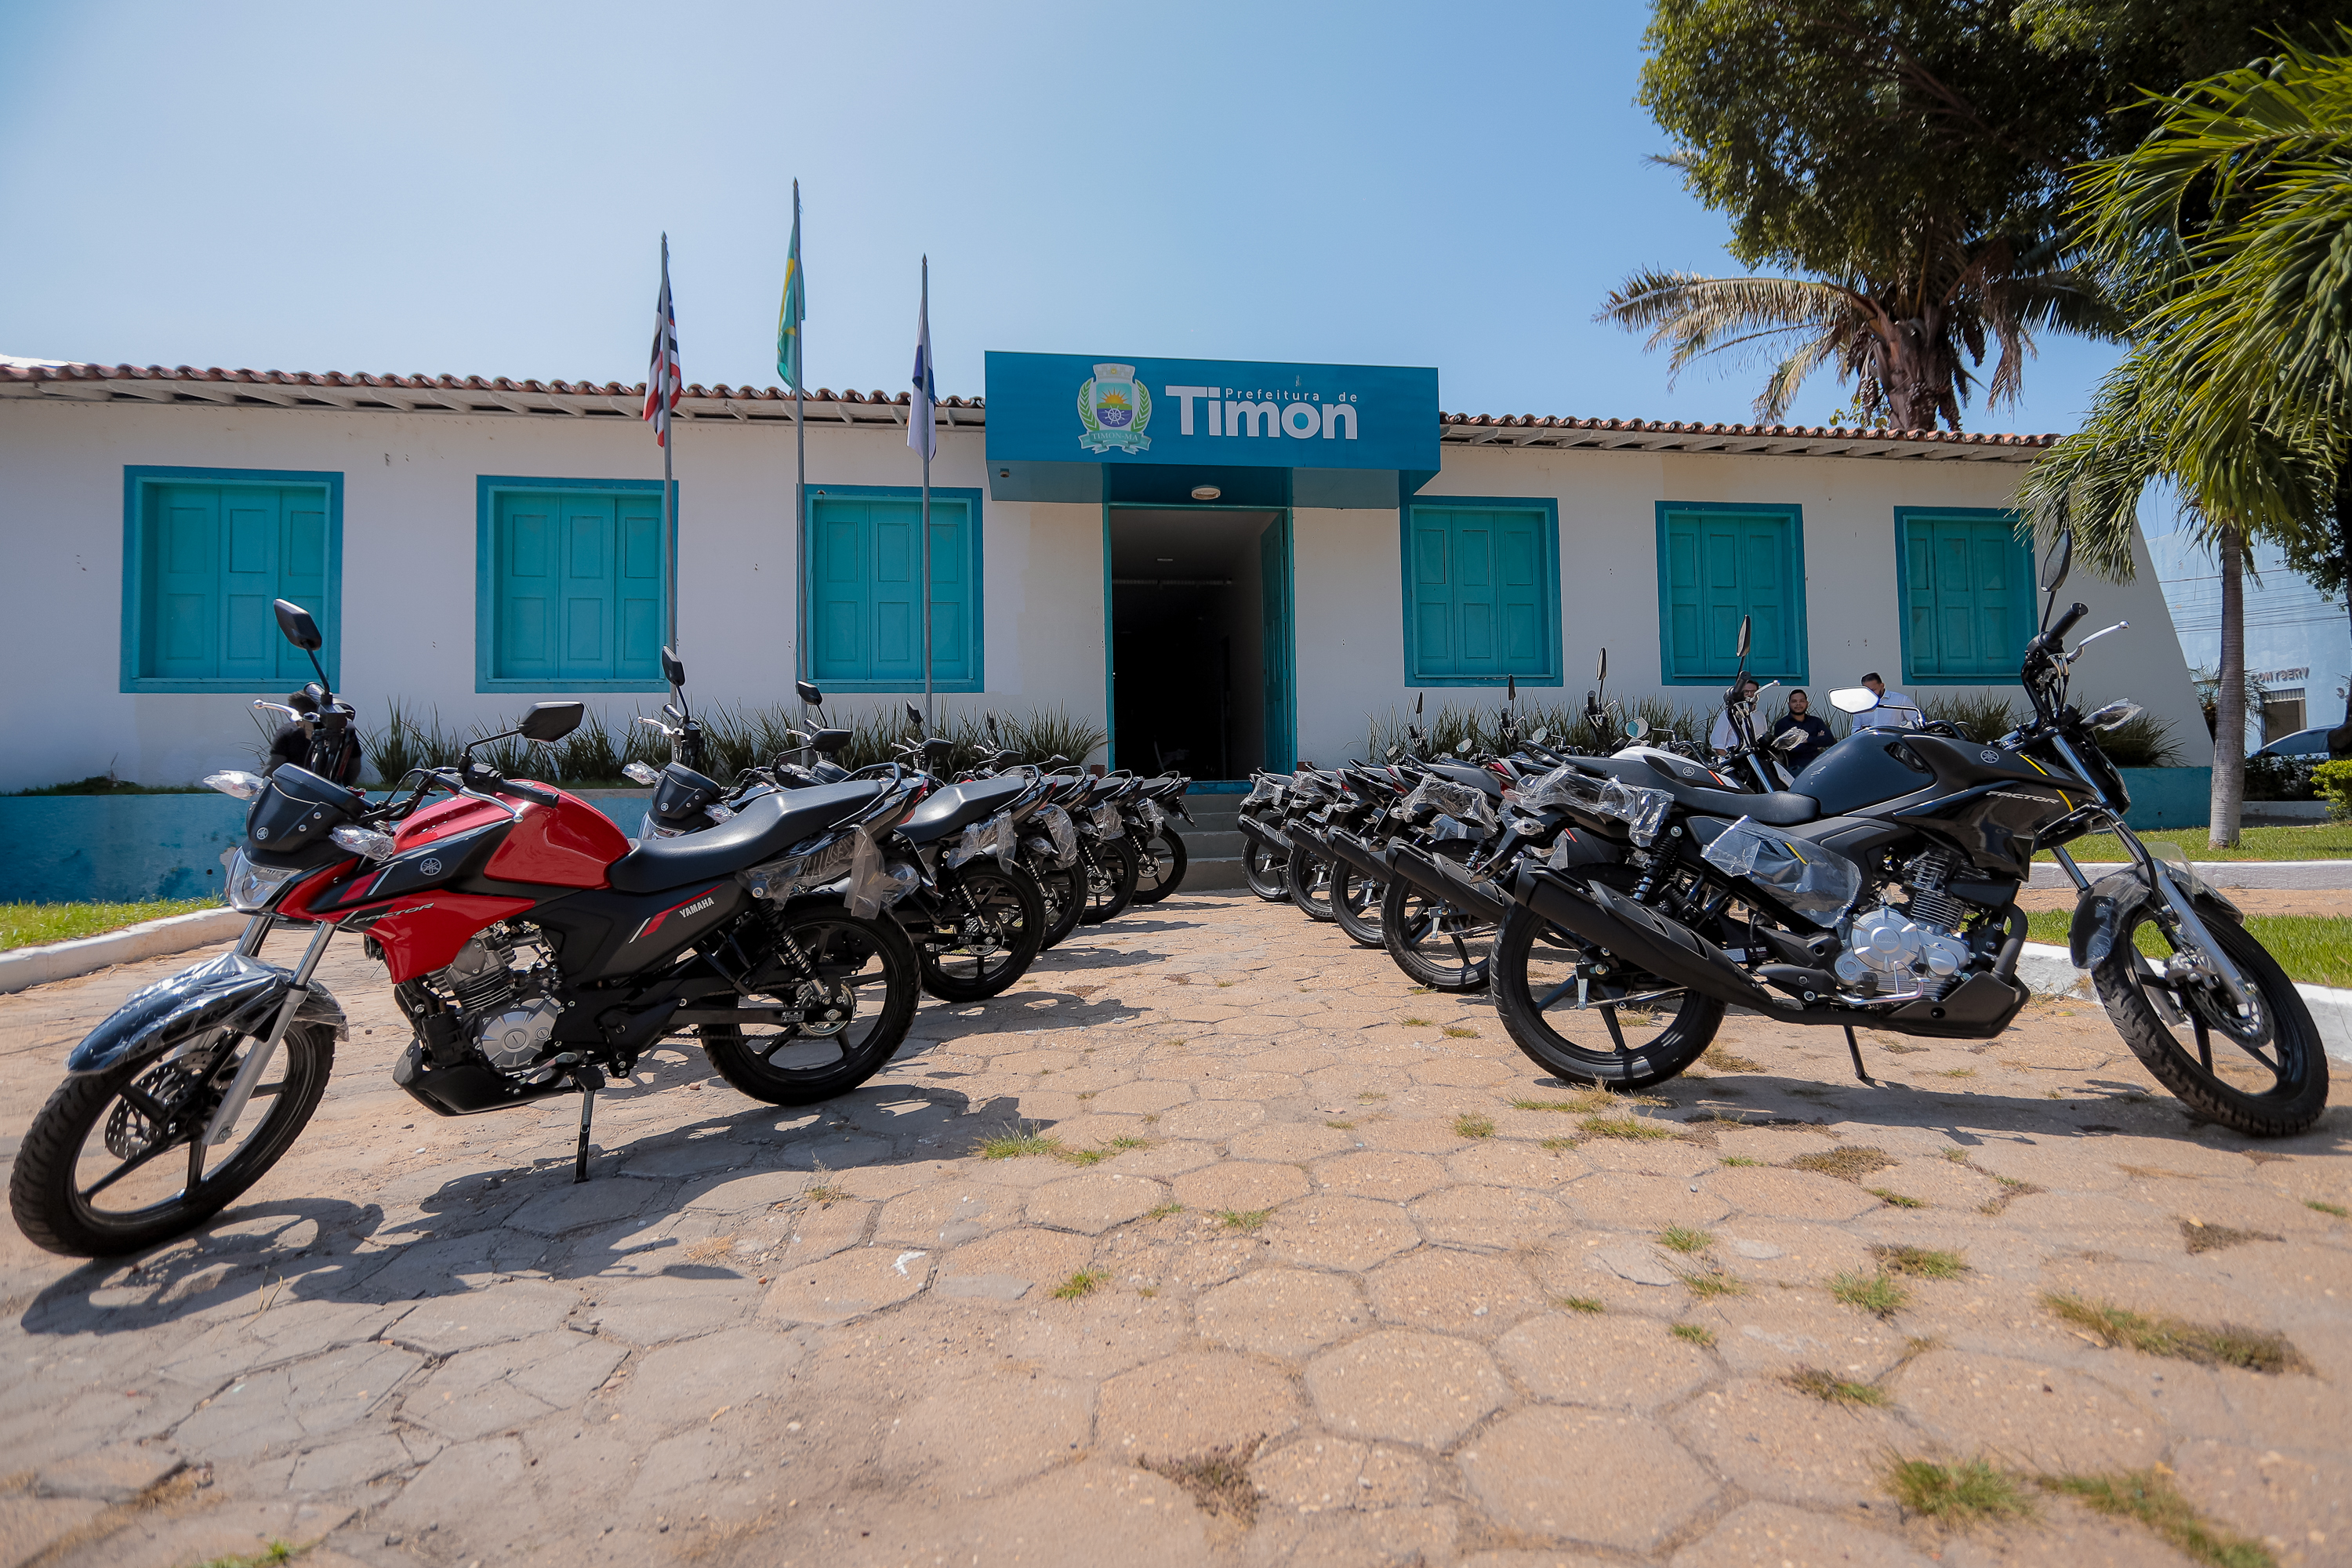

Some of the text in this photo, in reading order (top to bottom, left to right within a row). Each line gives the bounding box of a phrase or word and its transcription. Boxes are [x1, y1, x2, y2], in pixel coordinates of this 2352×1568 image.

[1225, 387, 1358, 402] Prefeitura de
[1165, 385, 1358, 440] Timon
[1091, 432, 1138, 441] TIMON-MA
[1986, 790, 2060, 804] FACTOR
[354, 902, 434, 924] FACTOR
[678, 896, 715, 918] YAMAHA
